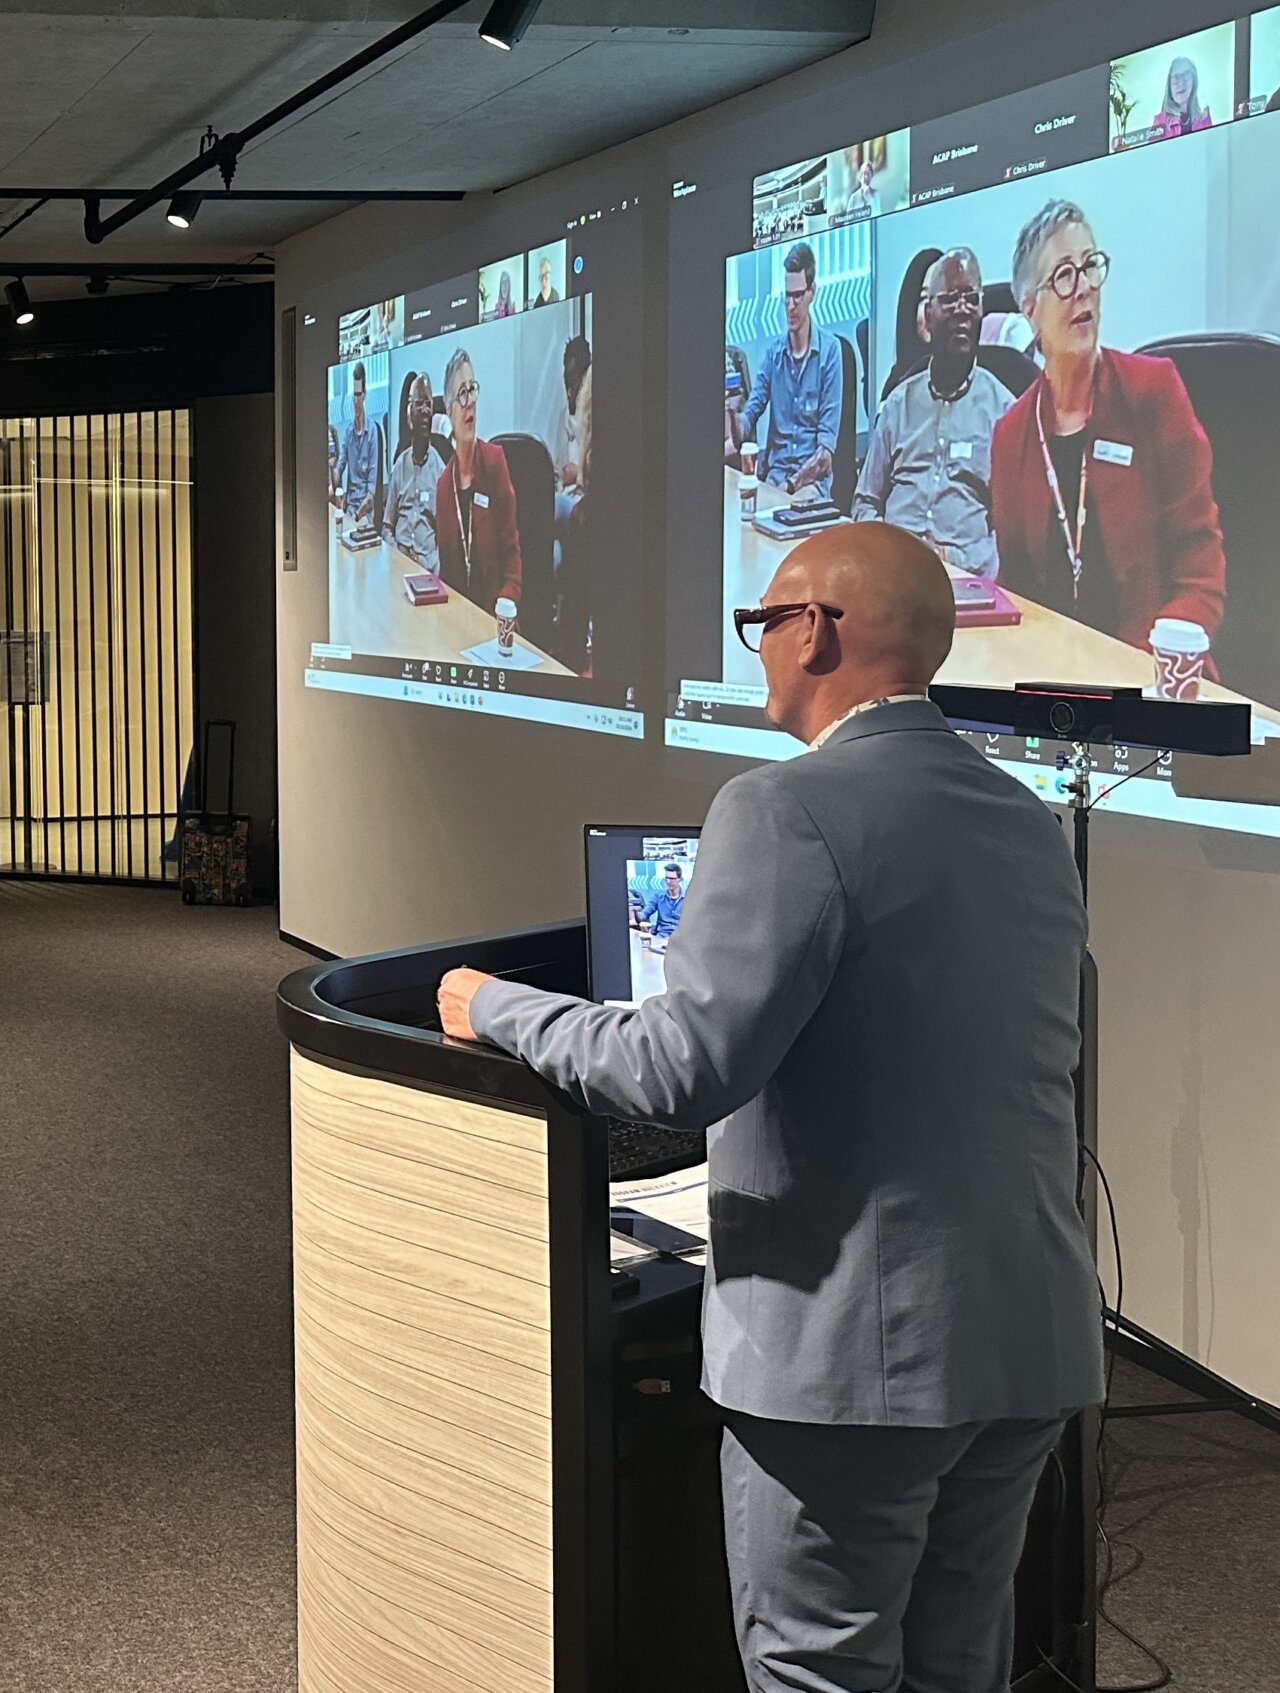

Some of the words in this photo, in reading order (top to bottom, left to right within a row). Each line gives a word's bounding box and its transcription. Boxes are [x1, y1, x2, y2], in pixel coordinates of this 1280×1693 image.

[1034, 121, 1052, 134] Chris
[1053, 115, 1076, 129] Driver
[932, 151, 950, 165] ACAP
[951, 145, 978, 159] Brisbane
[1013, 164, 1027, 175] Chris
[1027, 160, 1046, 171] Driver
[918, 190, 931, 201] ACAP
[932, 186, 954, 198] Brisbane
[985, 745, 1000, 756] React
[1025, 751, 1040, 760] Share
[1114, 762, 1129, 772] Apps
